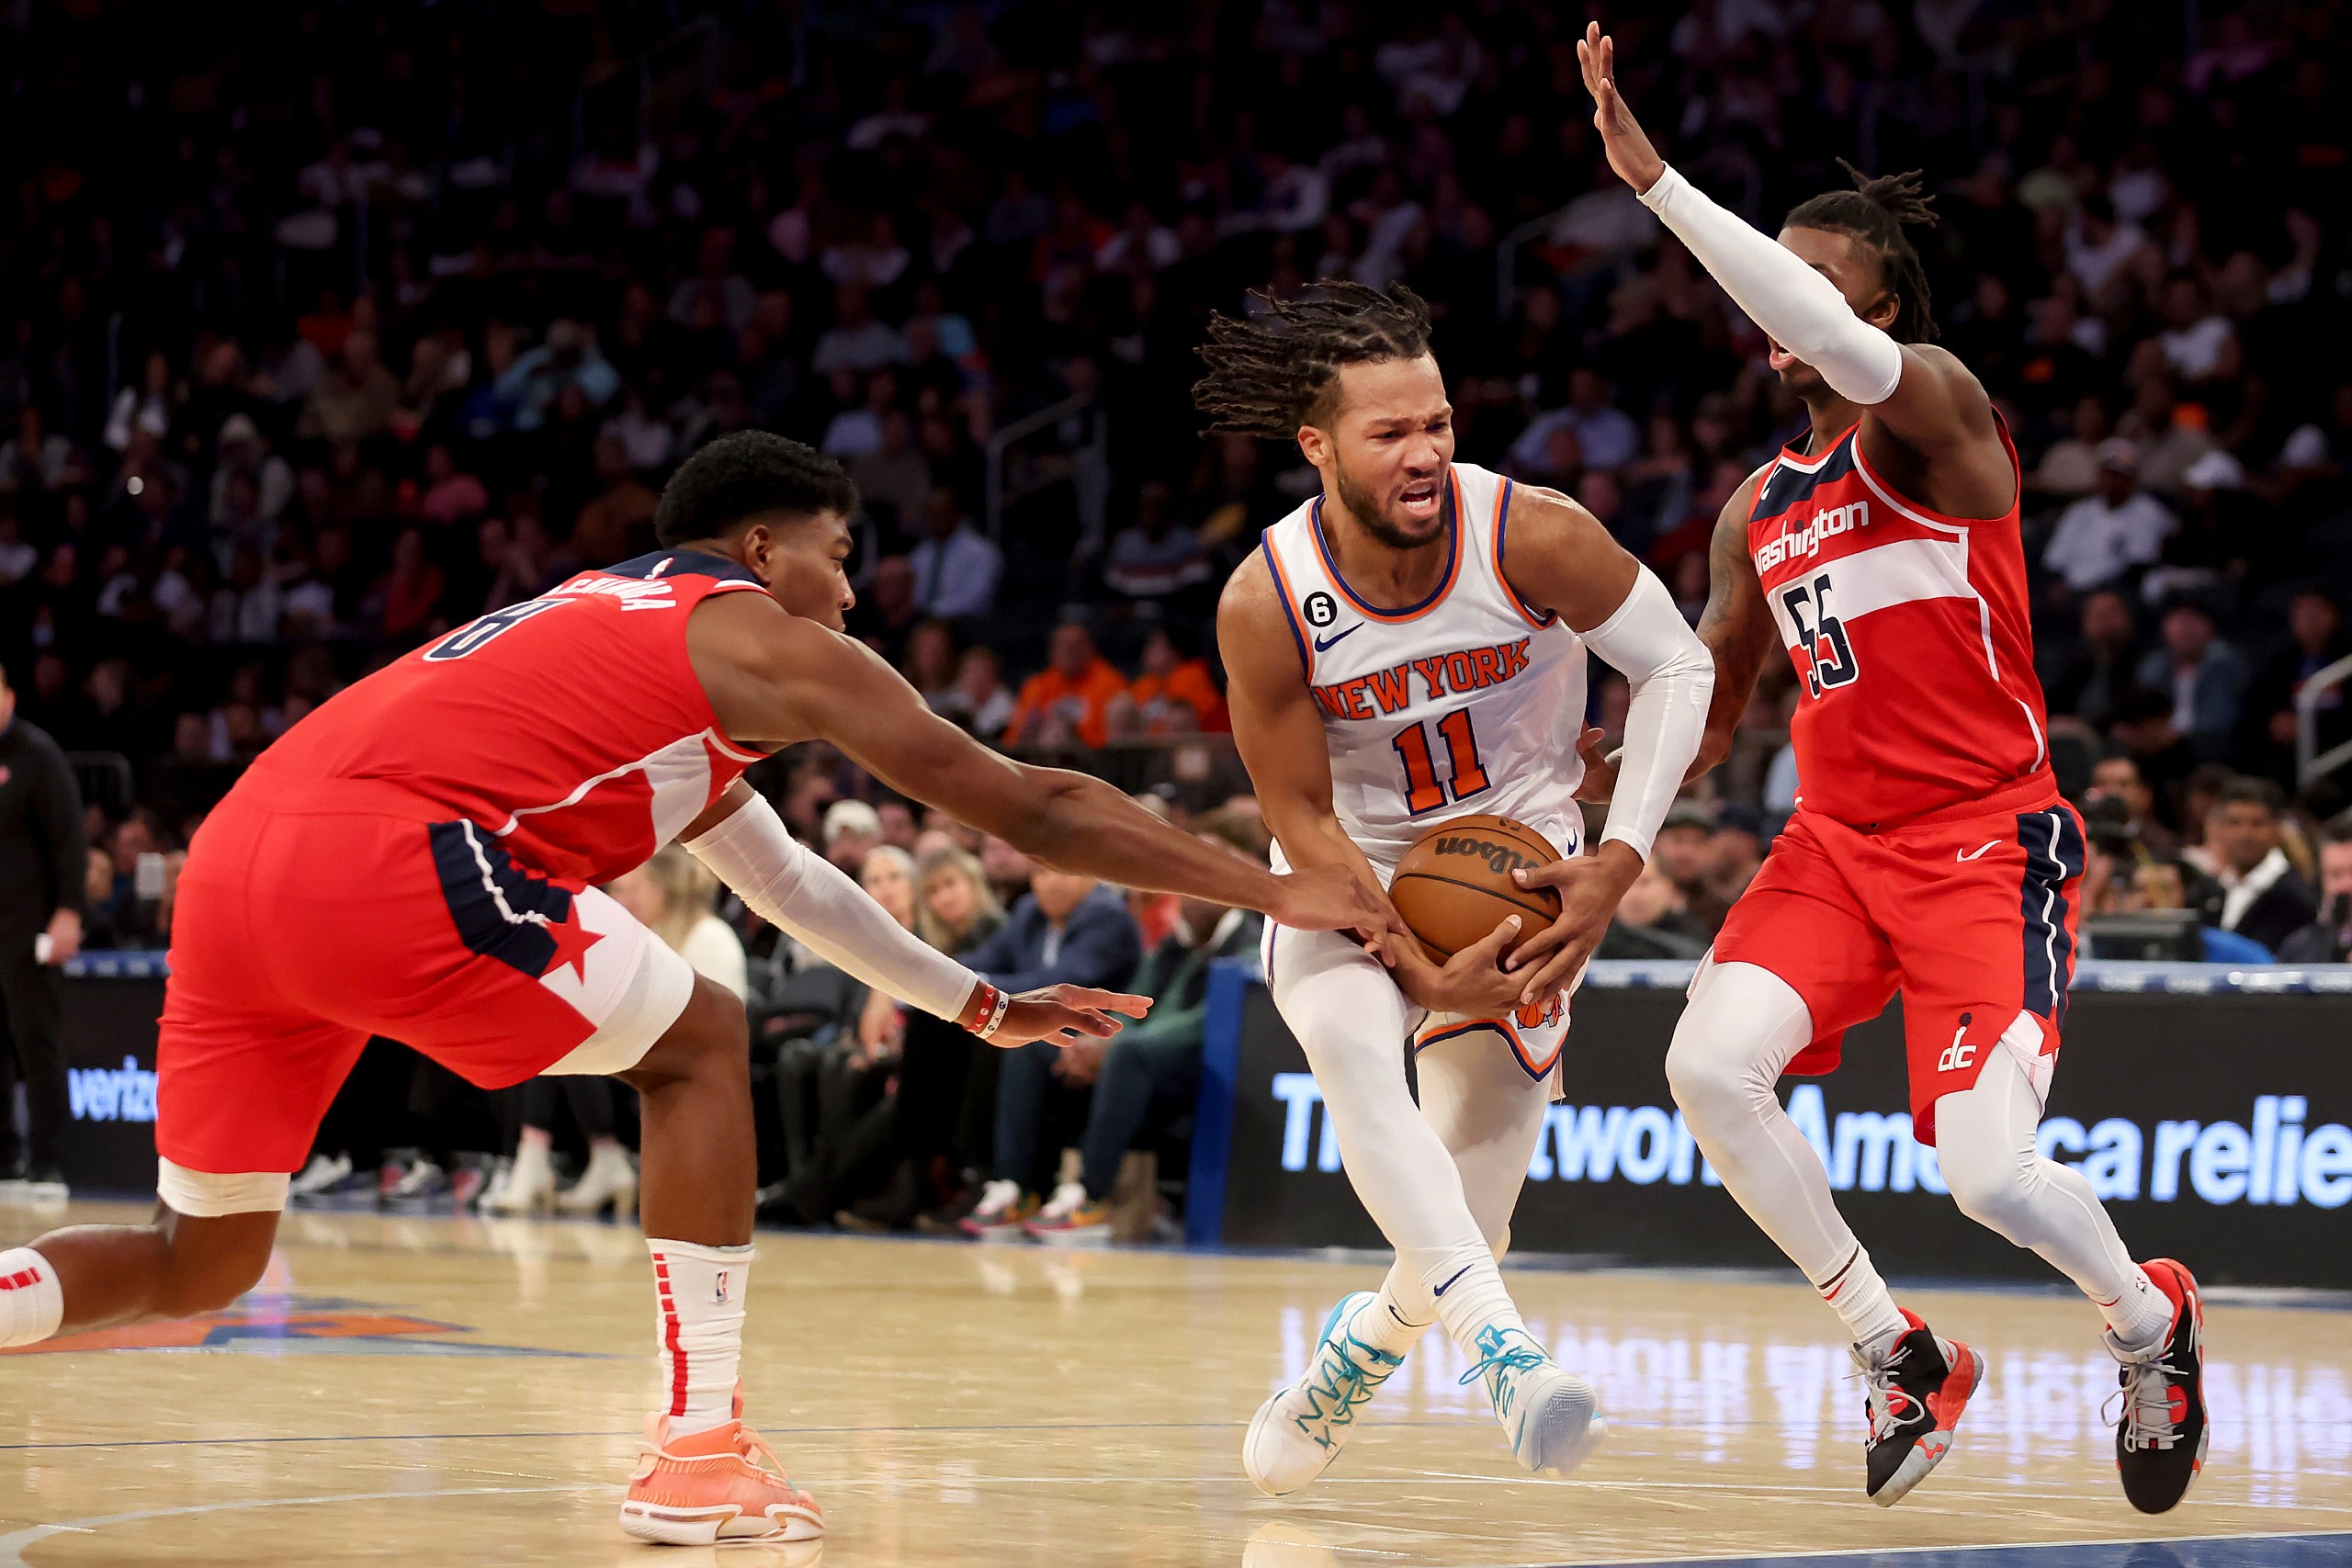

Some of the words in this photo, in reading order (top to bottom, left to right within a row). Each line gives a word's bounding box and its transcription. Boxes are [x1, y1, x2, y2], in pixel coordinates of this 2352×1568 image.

[422, 597, 577, 661] 8
[1311, 596, 1330, 625] 6
[1780, 571, 1859, 700] 55
[1313, 660, 1411, 720] NEW
[1413, 635, 1532, 703] YORK
[1391, 706, 1492, 816] 11
